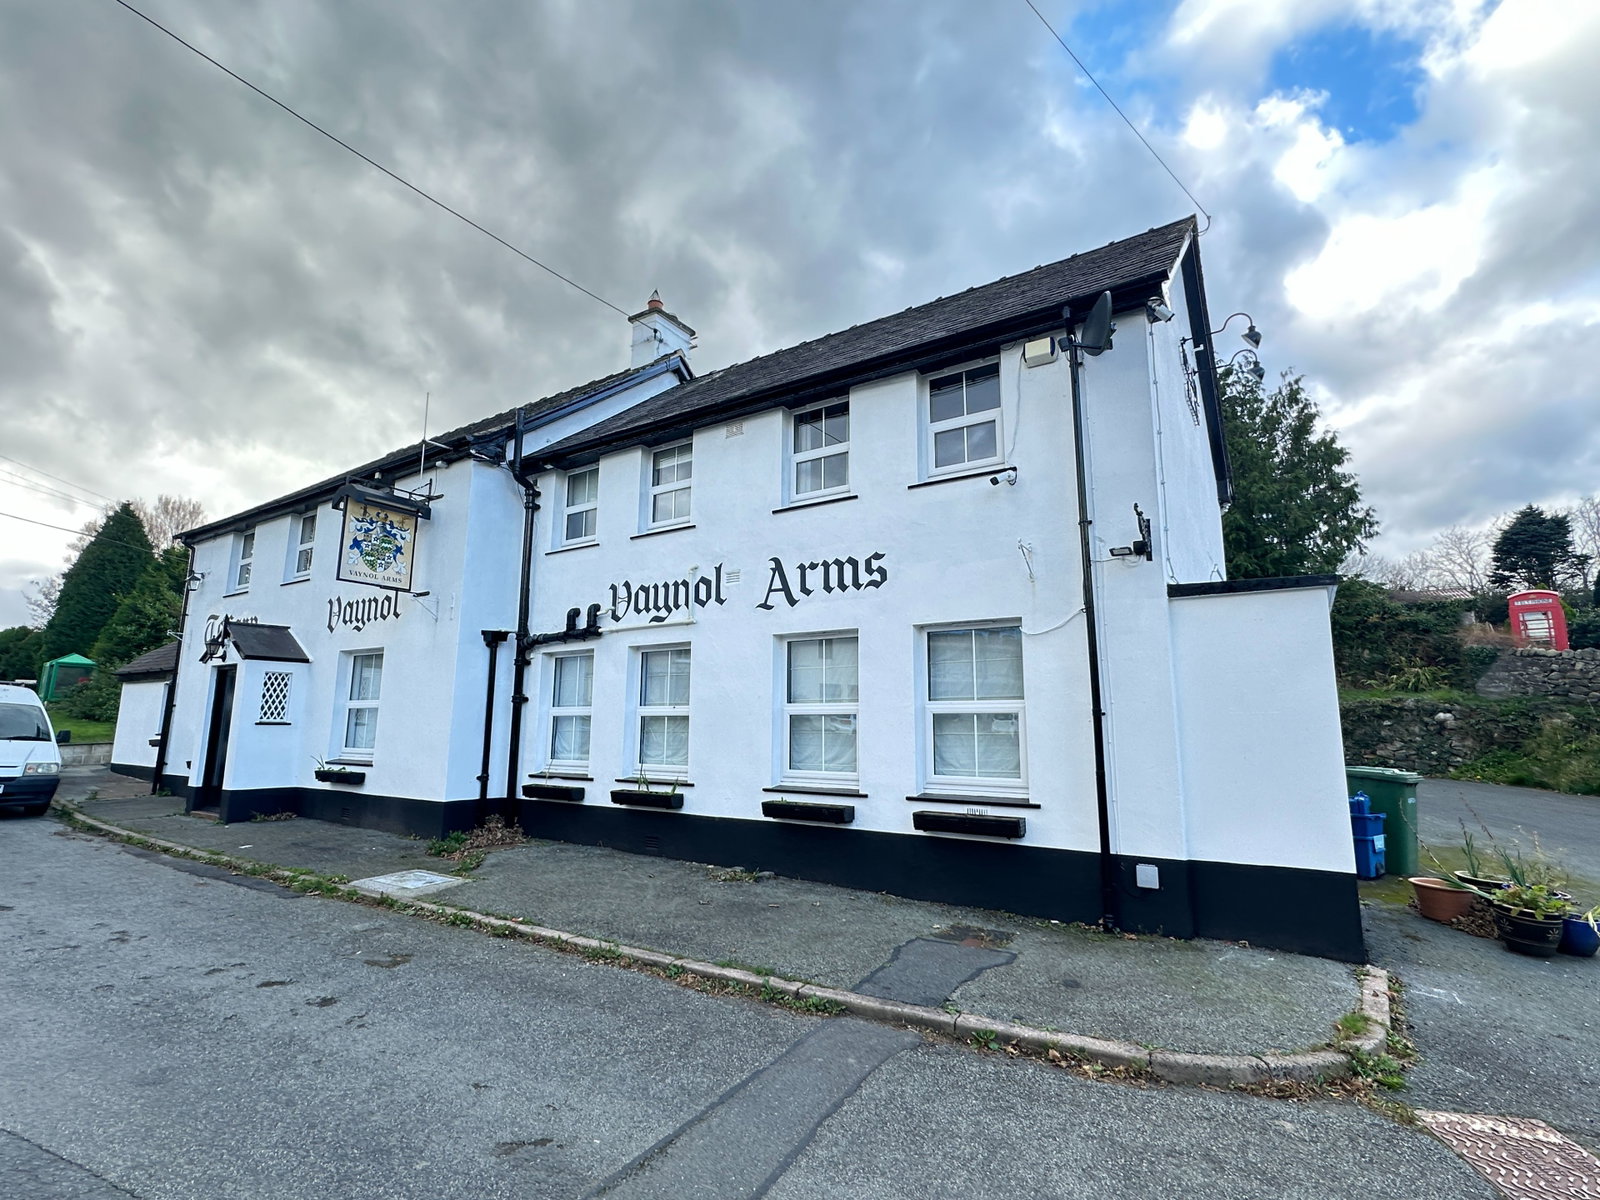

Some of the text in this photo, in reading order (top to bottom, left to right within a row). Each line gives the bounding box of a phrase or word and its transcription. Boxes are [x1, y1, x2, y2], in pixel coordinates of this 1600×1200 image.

[349, 570, 379, 580] VAYNOL
[608, 551, 888, 623] Vaynol Arms
[327, 590, 401, 633] Vaynol
